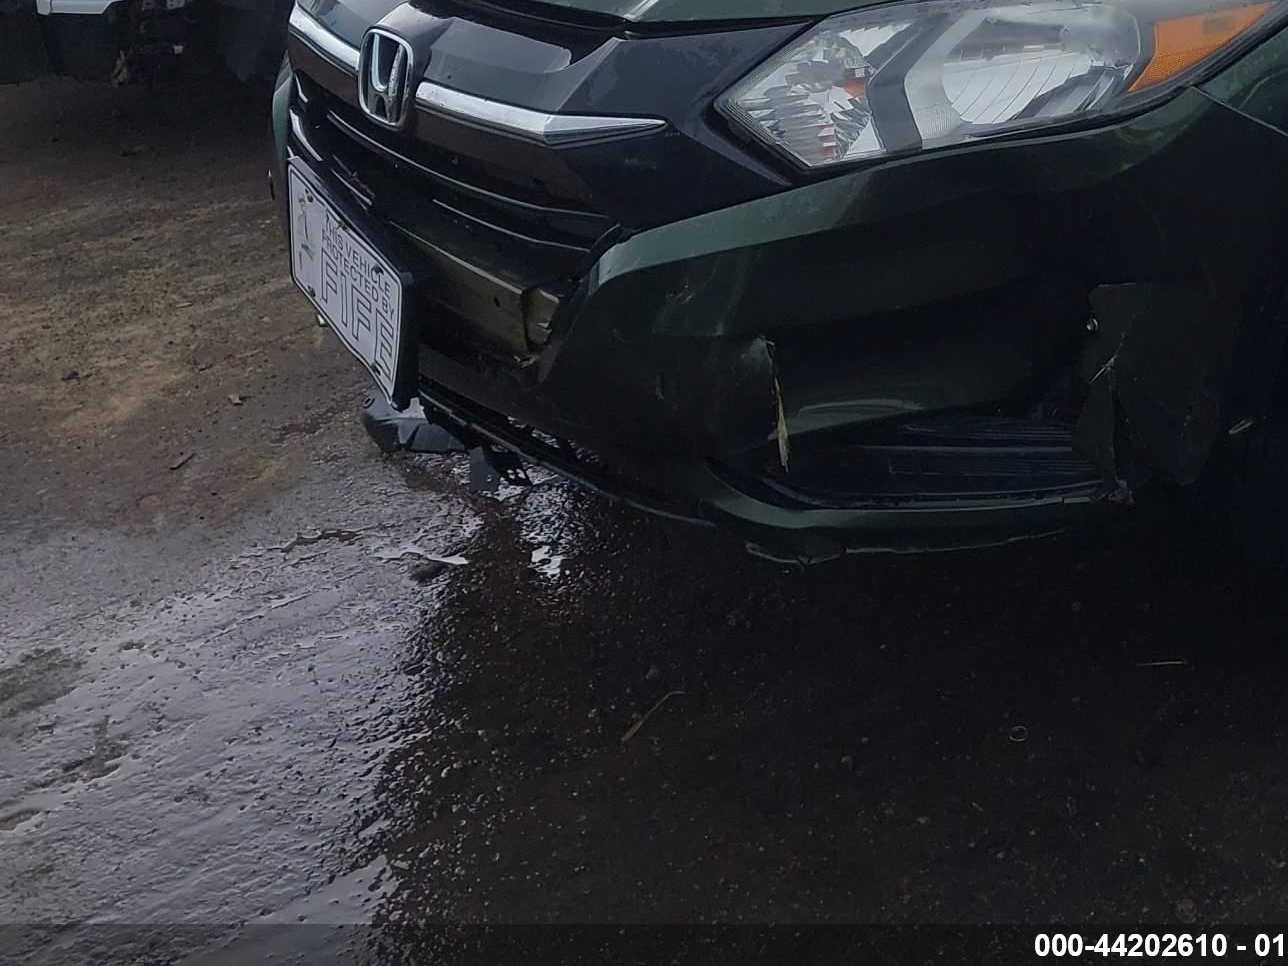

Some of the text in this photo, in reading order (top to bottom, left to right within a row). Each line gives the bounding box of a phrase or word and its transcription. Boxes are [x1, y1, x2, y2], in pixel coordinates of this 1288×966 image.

[321, 226, 395, 322] PROTECTED BY
[324, 213, 391, 301] THIS VEHICLE
